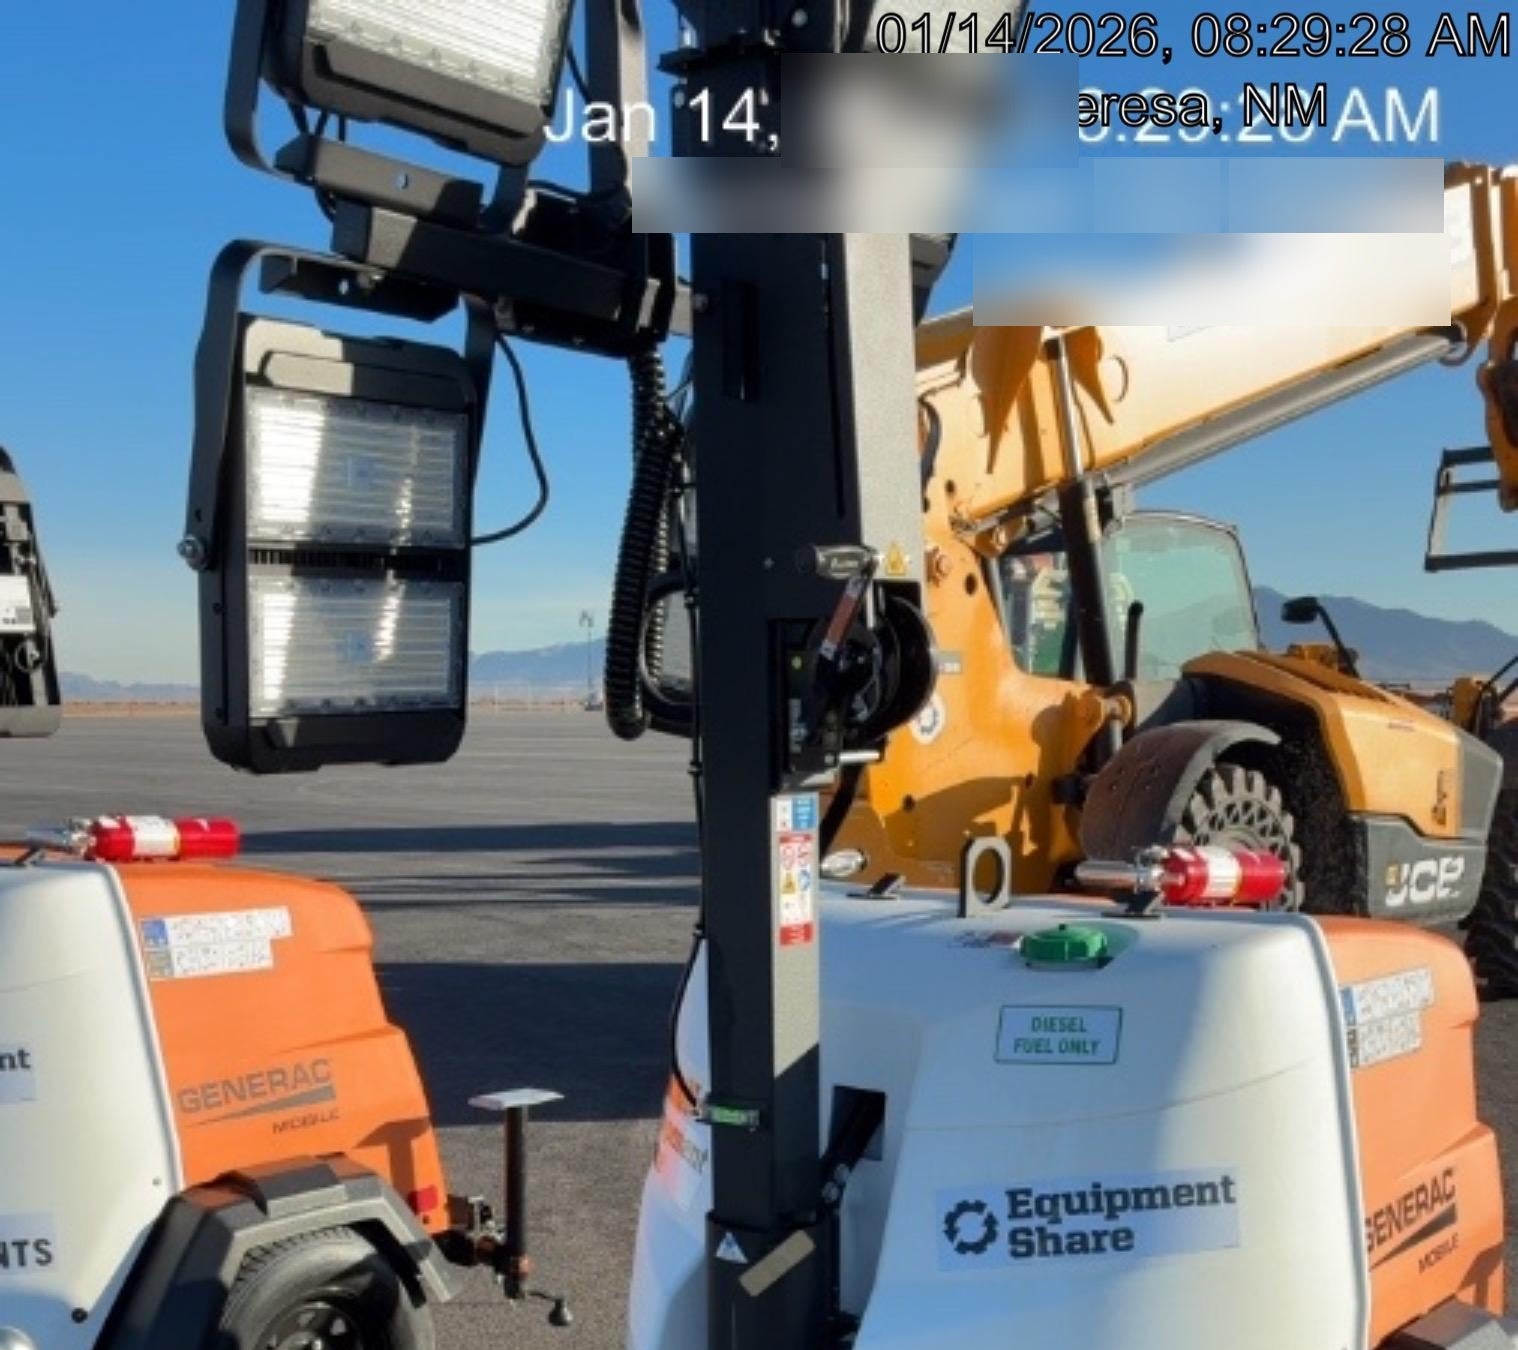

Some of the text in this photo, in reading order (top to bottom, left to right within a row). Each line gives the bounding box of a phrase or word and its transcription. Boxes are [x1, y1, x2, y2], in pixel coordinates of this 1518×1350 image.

[1031, 1016, 1087, 1033] DIESEL
[1013, 1037, 1101, 1055] FUEL ONLY
[178, 1058, 331, 1114] GENERAC
[1005, 1175, 1236, 1225] Equipment
[1008, 1226, 1135, 1259] Share
